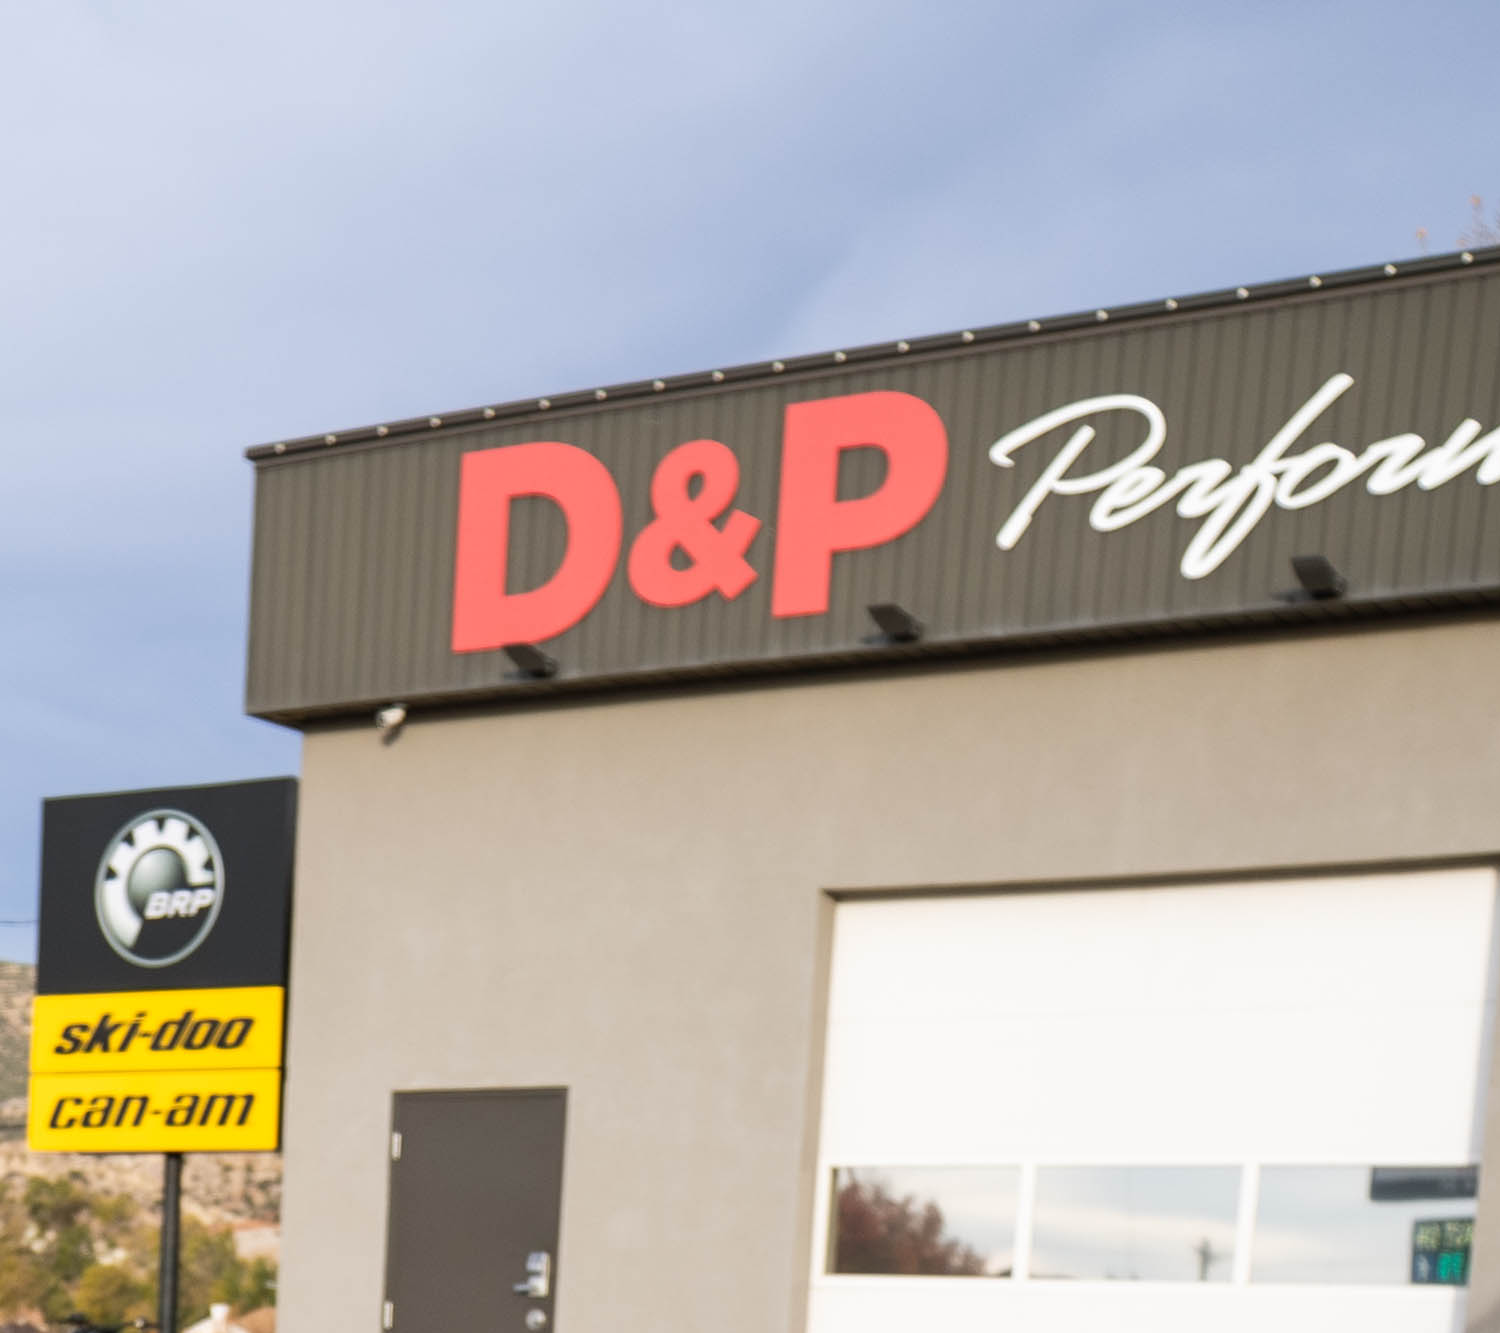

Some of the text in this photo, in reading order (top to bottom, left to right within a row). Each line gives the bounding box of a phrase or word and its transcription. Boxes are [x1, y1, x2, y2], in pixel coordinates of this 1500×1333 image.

[451, 389, 949, 654] D&P
[144, 888, 215, 919] BRP
[54, 1010, 255, 1055] ski-doo
[48, 1092, 256, 1129] can-am
